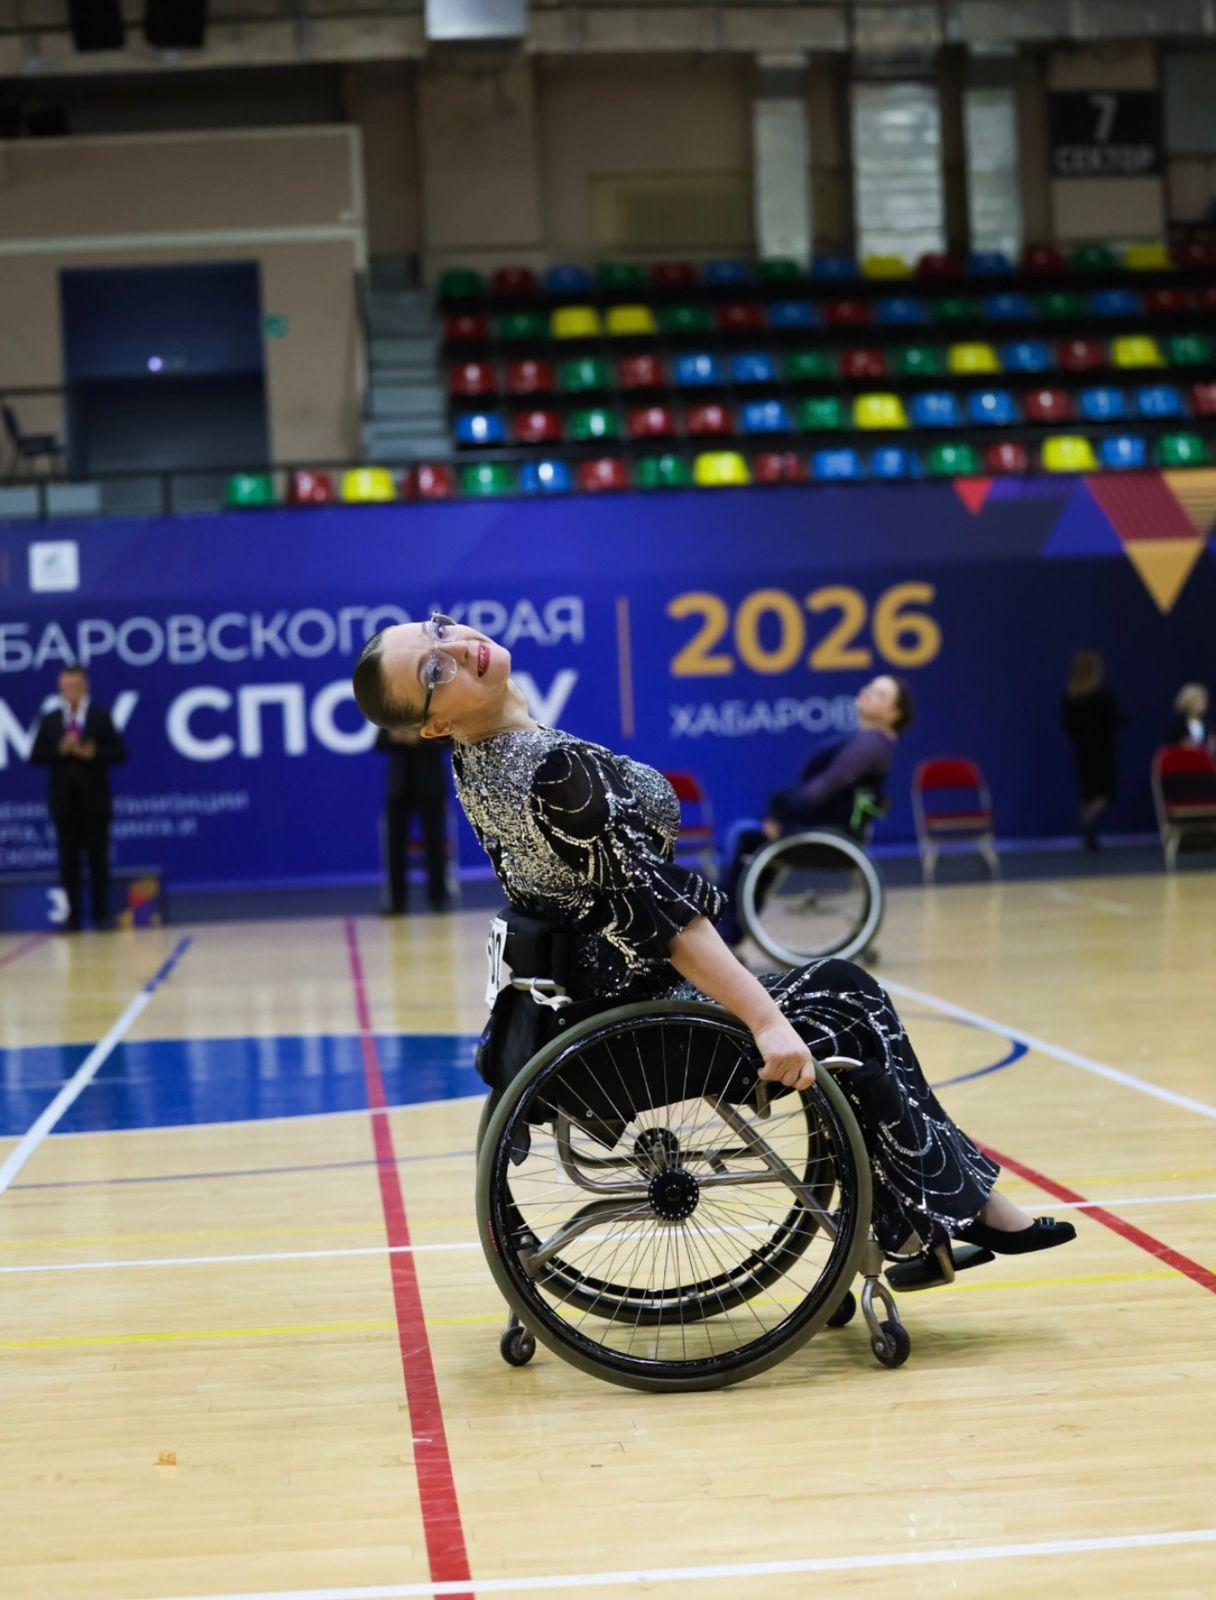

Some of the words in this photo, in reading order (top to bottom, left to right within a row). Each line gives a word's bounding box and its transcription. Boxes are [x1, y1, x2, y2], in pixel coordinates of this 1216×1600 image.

[1088, 96, 1118, 142] 7
[667, 581, 942, 678] 2026
[165, 668, 579, 762] СПОУ
